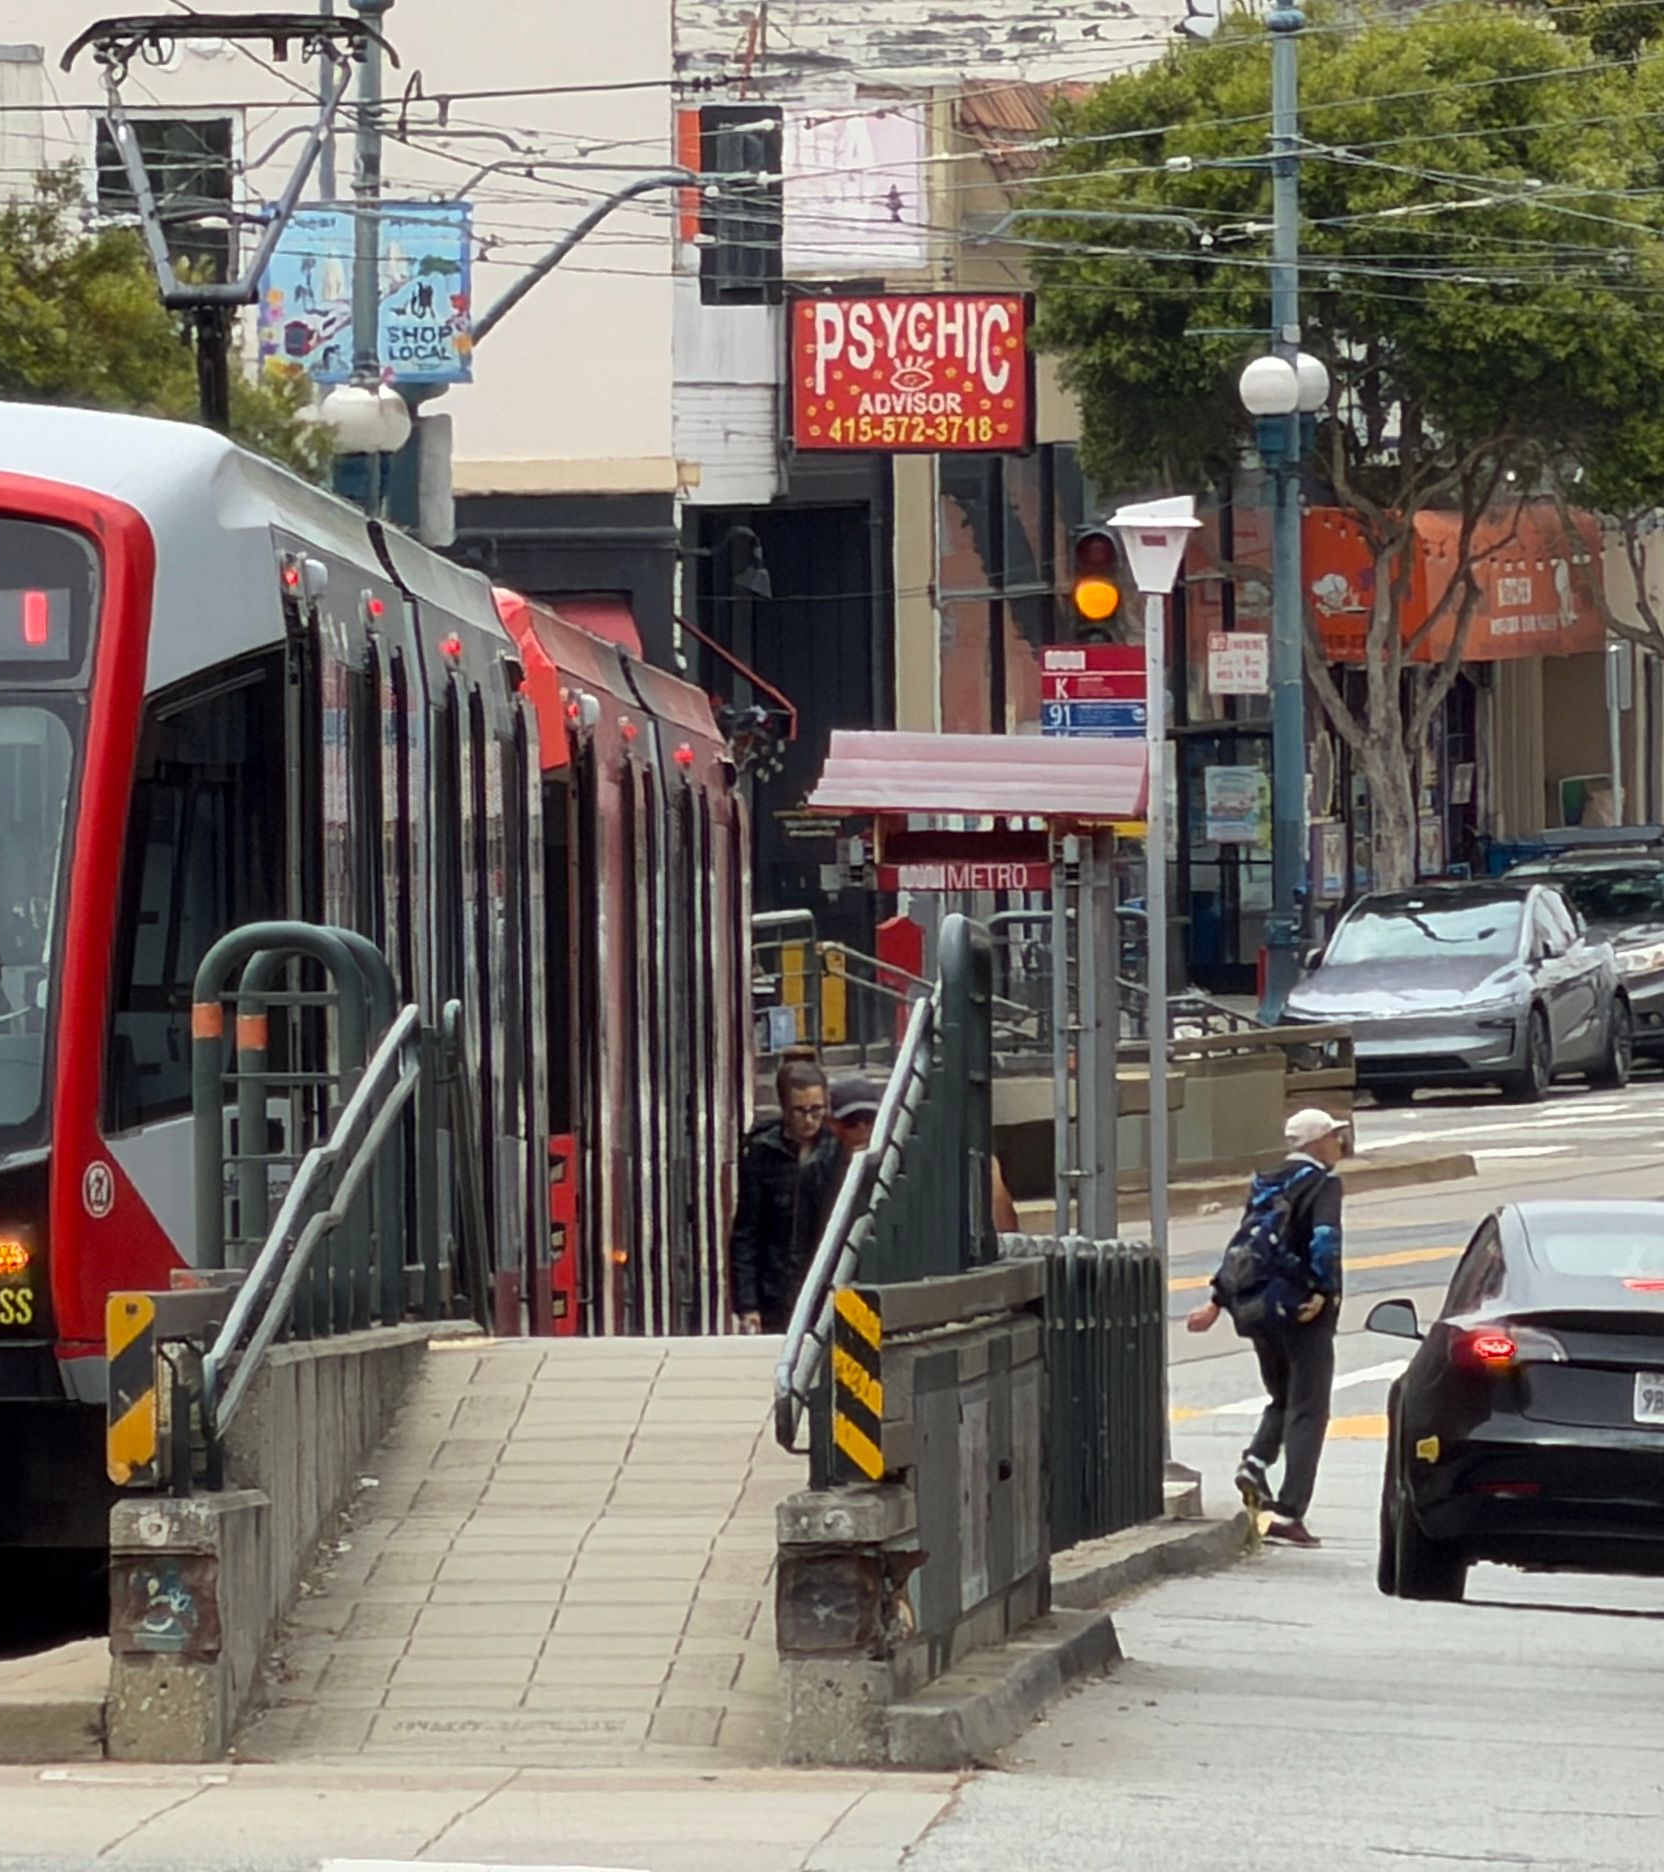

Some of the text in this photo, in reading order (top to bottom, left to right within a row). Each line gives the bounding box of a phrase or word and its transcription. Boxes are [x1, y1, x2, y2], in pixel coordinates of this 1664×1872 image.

[387, 325, 453, 344] SHOP
[388, 345, 452, 361] LOCAL
[815, 302, 1010, 395] PSYCHIC
[858, 392, 963, 415] ADVISOR
[828, 416, 993, 443] 415-572-3718
[1055, 677, 1069, 699] K
[1049, 704, 1071, 726] 91
[947, 863, 1028, 889] METRO
